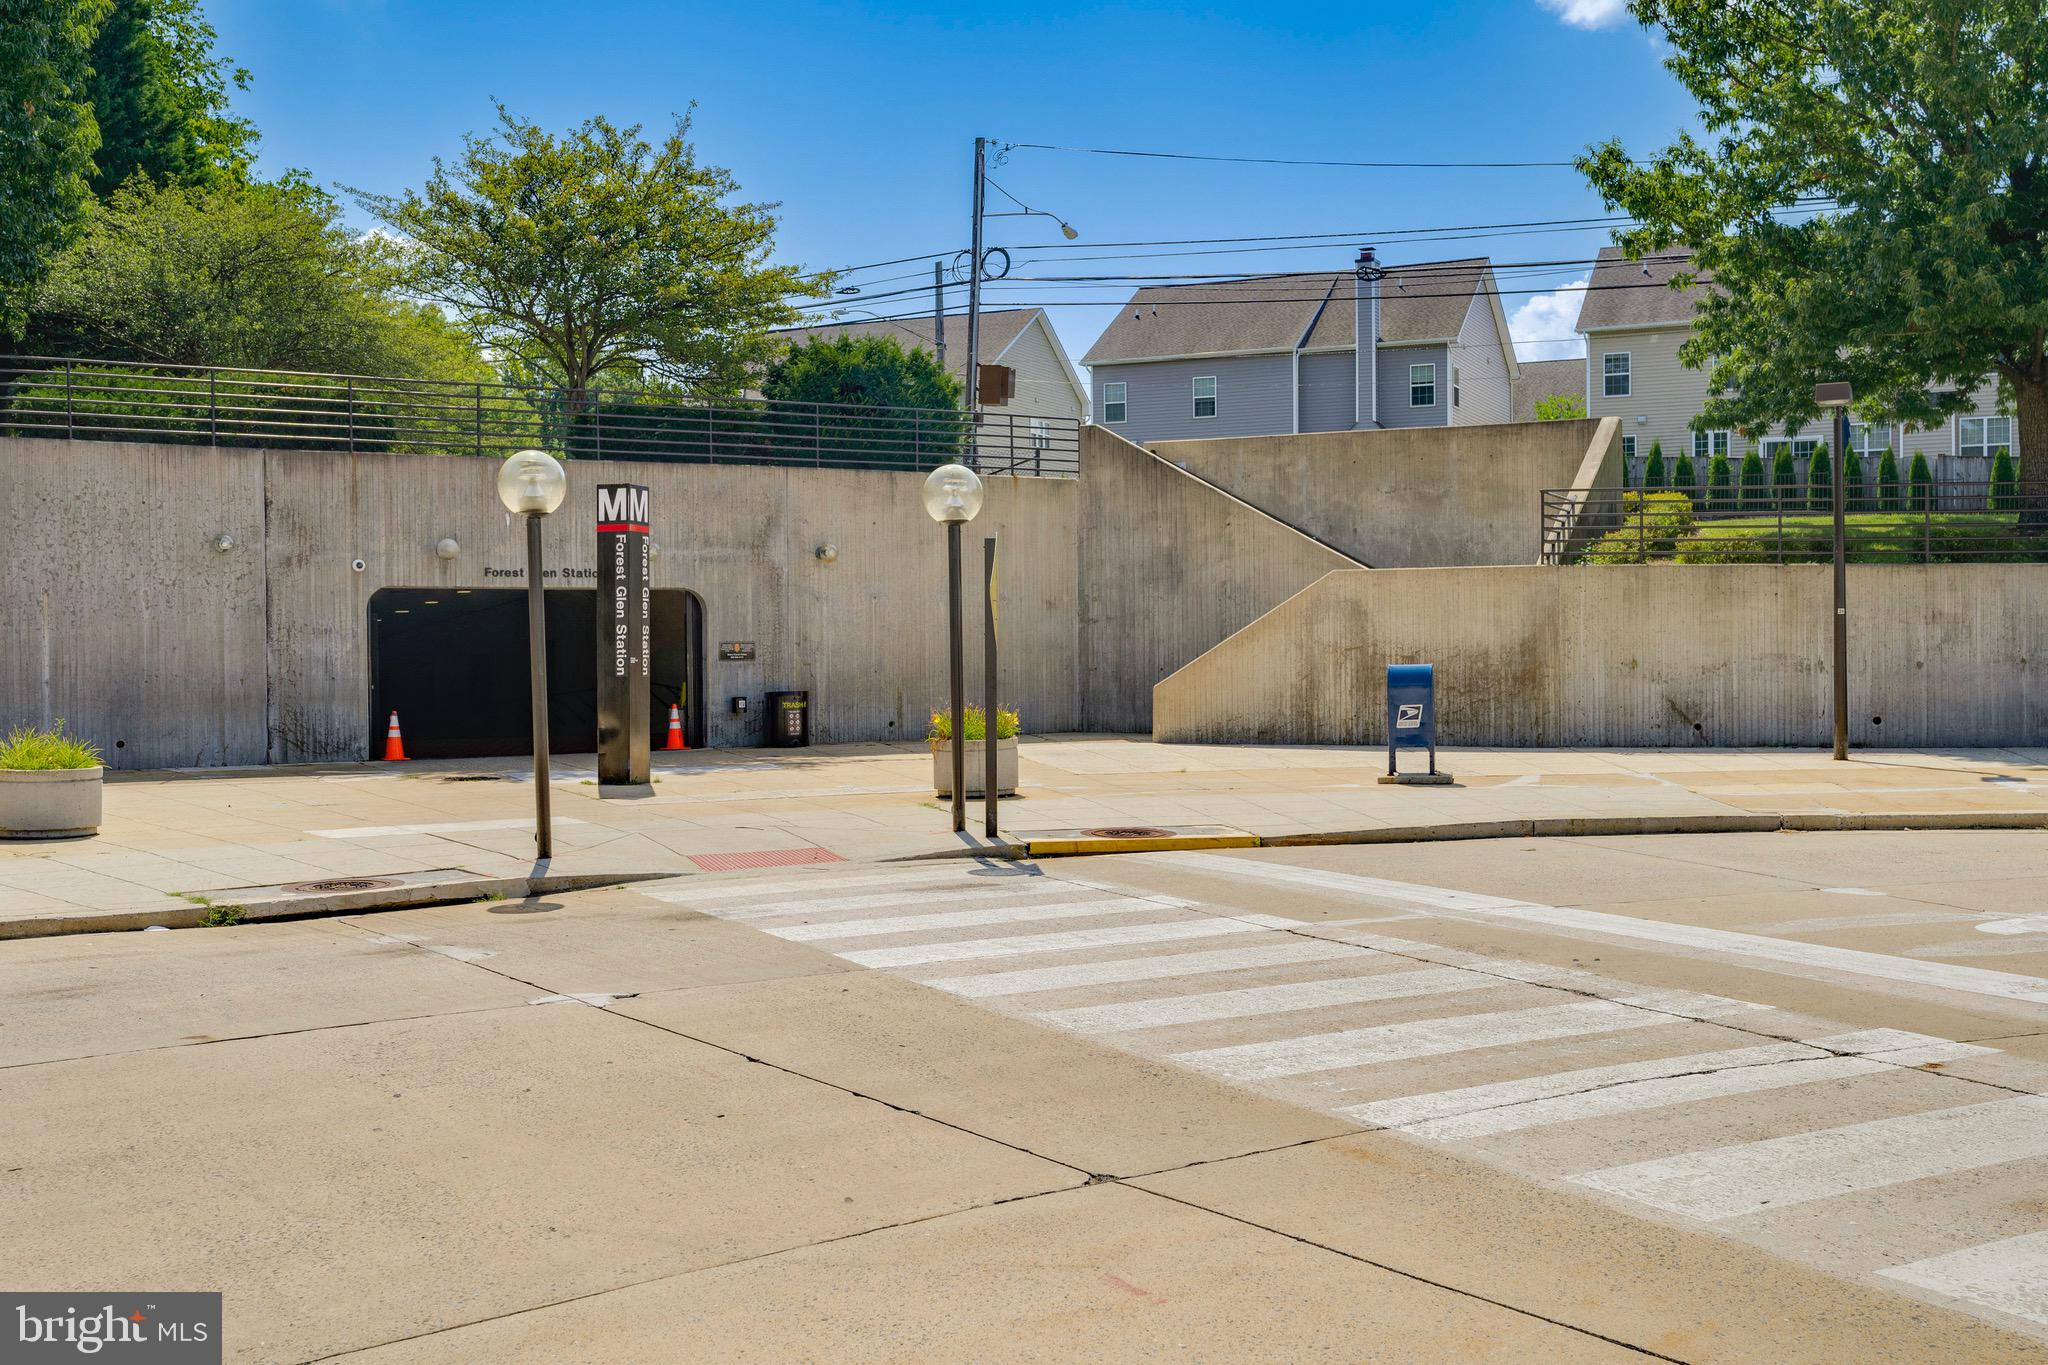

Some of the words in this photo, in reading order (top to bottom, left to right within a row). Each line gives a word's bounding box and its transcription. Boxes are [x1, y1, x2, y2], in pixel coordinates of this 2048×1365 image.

[598, 487, 627, 522] M
[630, 488, 649, 523] M
[484, 567, 525, 578] Forest
[543, 569, 557, 578] en
[616, 534, 627, 580] Forest
[641, 536, 649, 581] Forest
[616, 586, 627, 618] Glen
[641, 587, 649, 619] Glen
[616, 624, 627, 676] Station
[641, 625, 649, 676] Station
